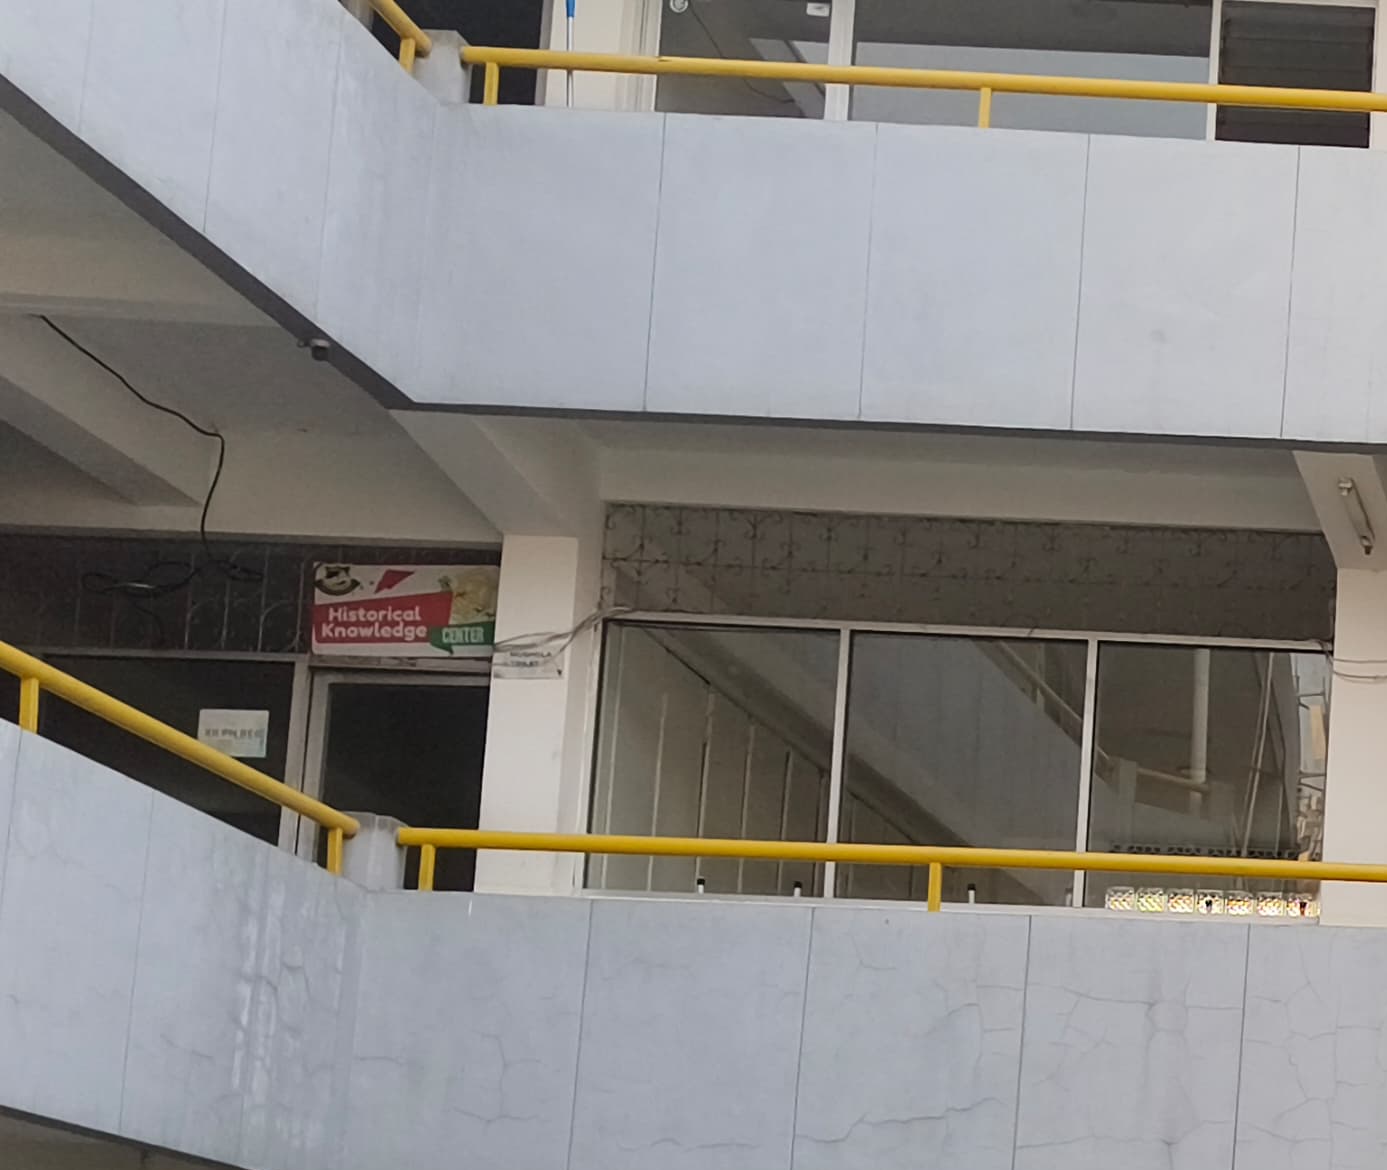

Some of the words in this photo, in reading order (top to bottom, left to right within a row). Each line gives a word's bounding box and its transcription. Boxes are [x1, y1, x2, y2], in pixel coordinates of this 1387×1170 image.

[328, 606, 421, 622] Historical
[321, 622, 428, 641] Knowledge
[442, 627, 484, 644] CENTER
